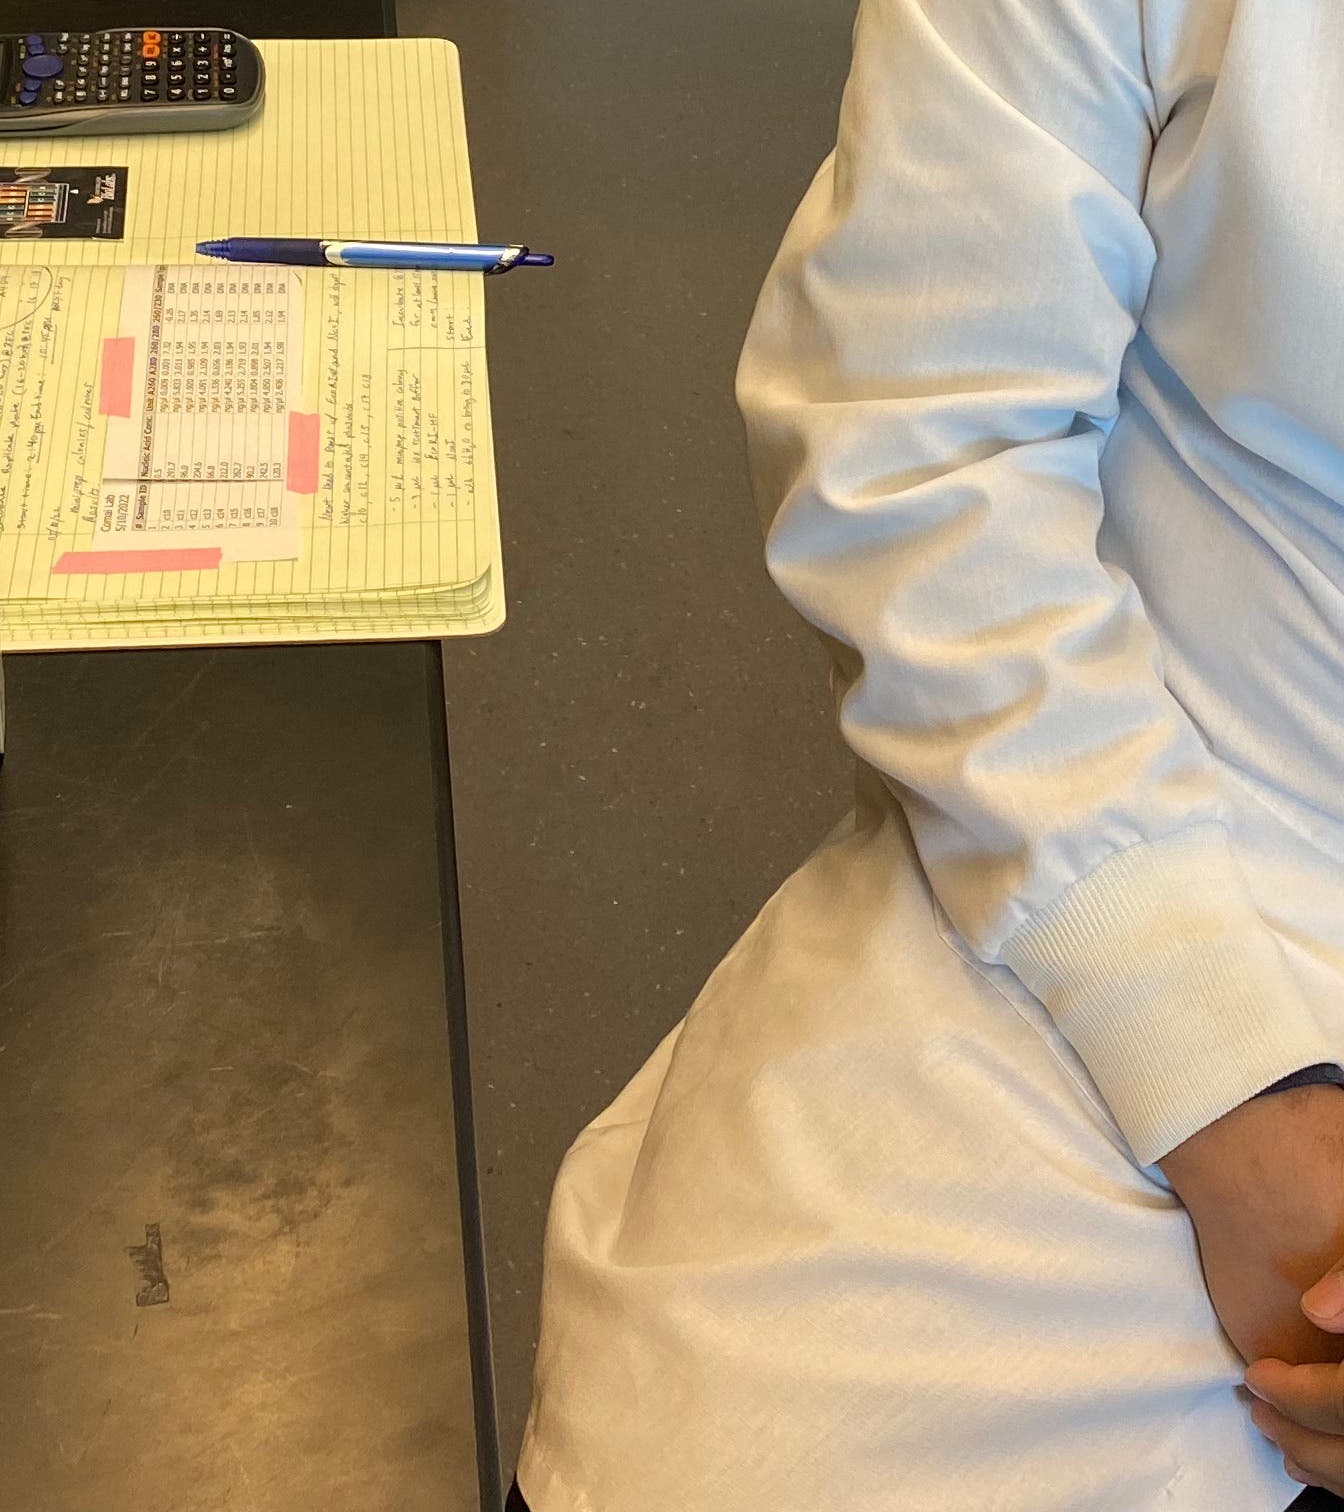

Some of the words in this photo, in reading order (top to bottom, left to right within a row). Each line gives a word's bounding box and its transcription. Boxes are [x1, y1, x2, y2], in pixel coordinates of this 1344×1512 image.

[148, 378, 156, 395] A260
[146, 398, 154, 411] Unit
[144, 416, 153, 434] Conc.
[141, 453, 150, 477] Nucleic
[139, 484, 147, 493] ID
[104, 494, 115, 507] Lab
[136, 495, 146, 520] Sample
[100, 510, 114, 532] Comai
[115, 494, 129, 531] 5/10/2022
